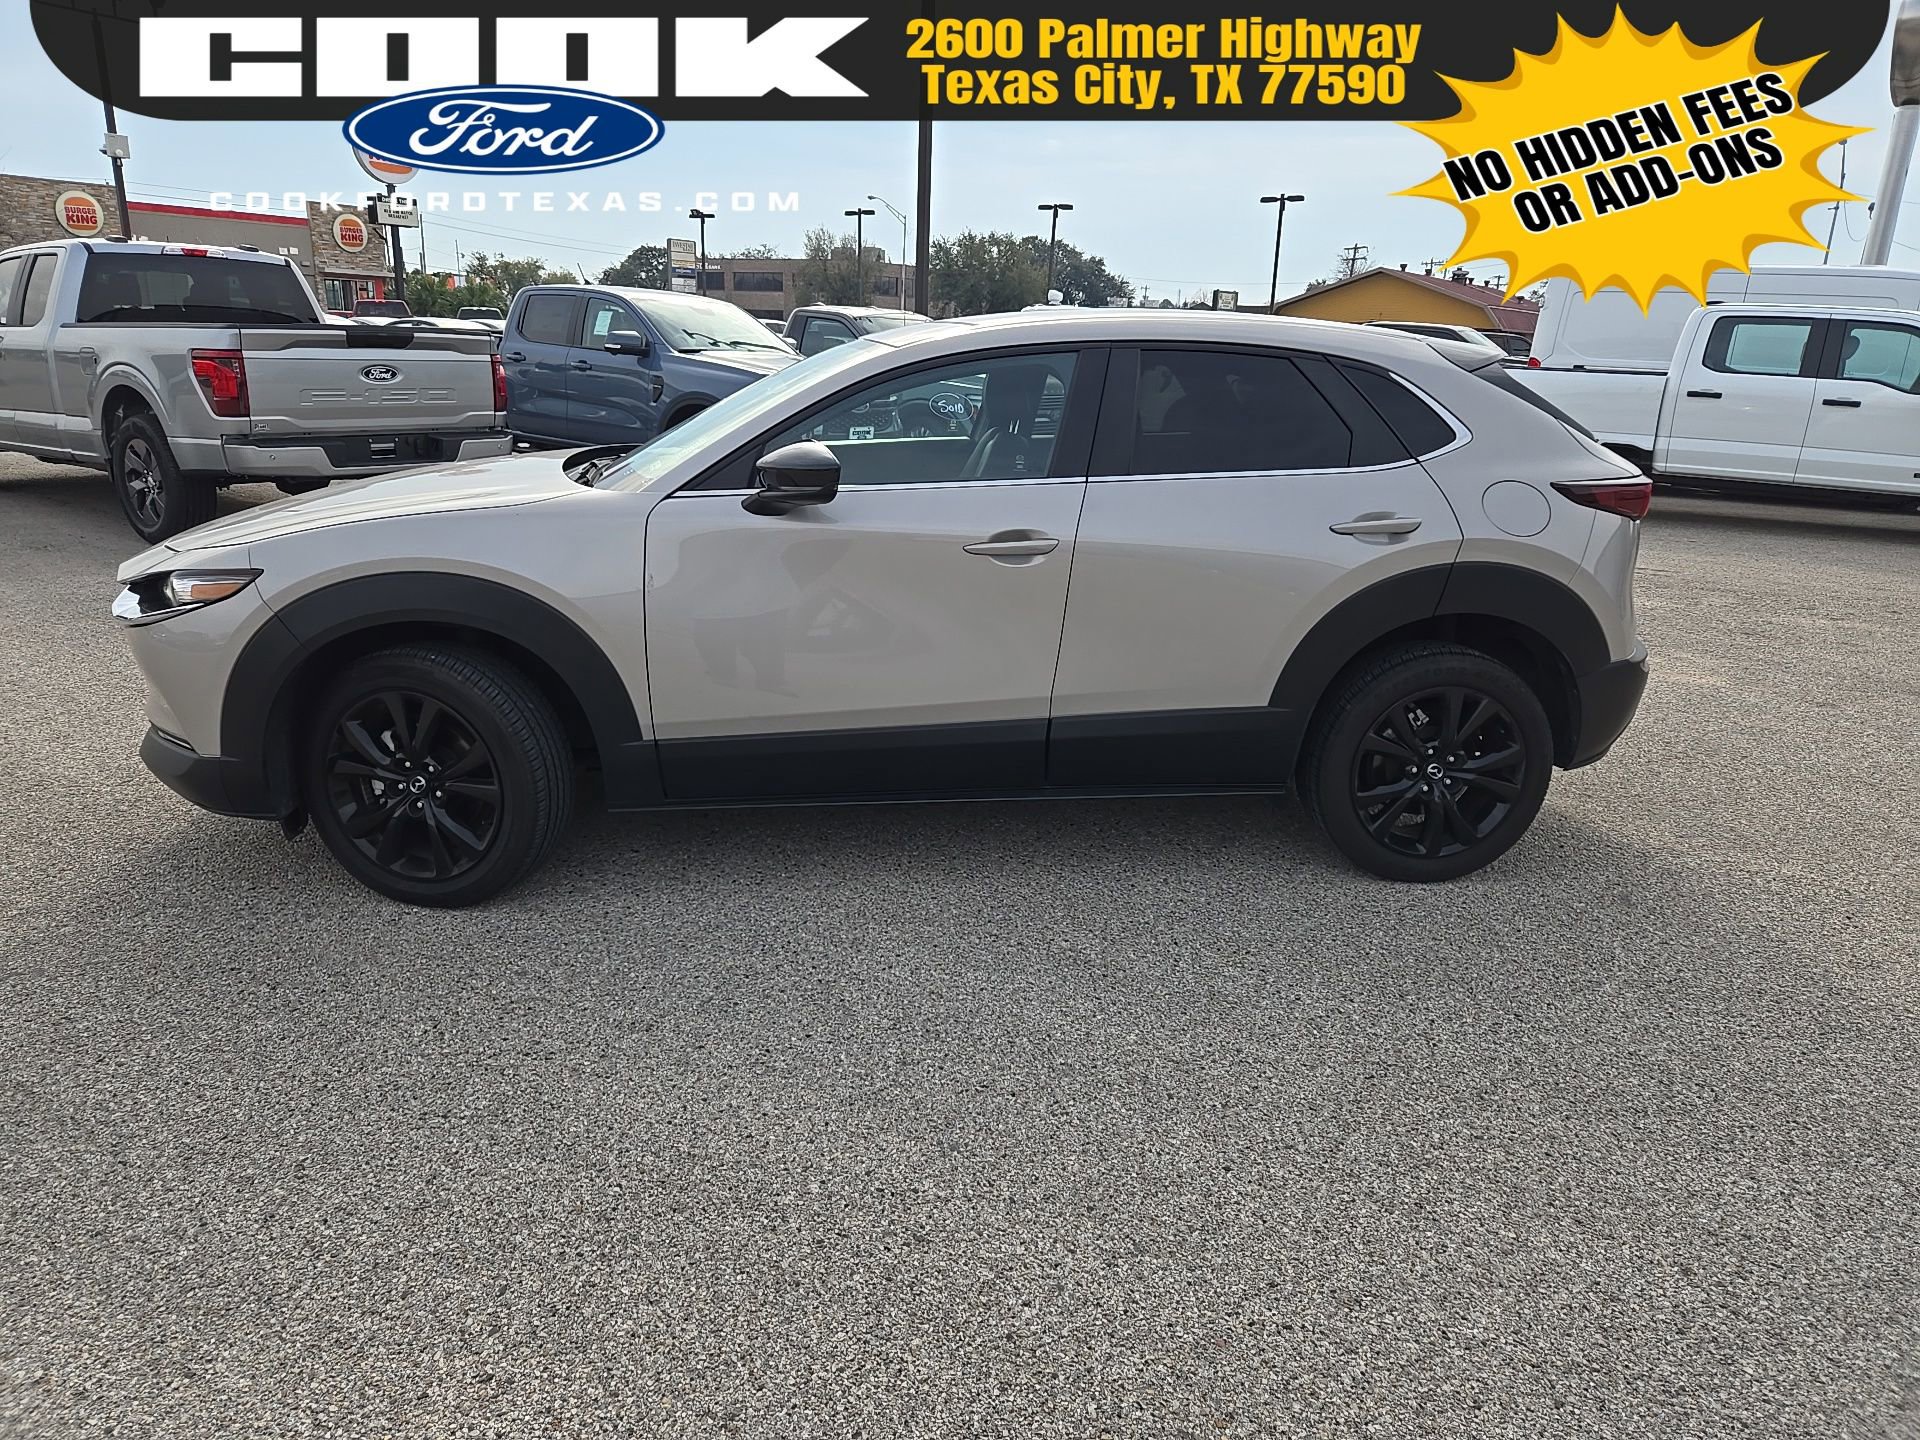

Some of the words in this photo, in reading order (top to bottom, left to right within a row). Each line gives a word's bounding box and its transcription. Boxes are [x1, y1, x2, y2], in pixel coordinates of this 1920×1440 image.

[64, 206, 97, 215] BURGER
[65, 214, 98, 225] KING
[340, 233, 364, 243] KING
[369, 368, 392, 379] Ford
[300, 388, 458, 406] F-150
